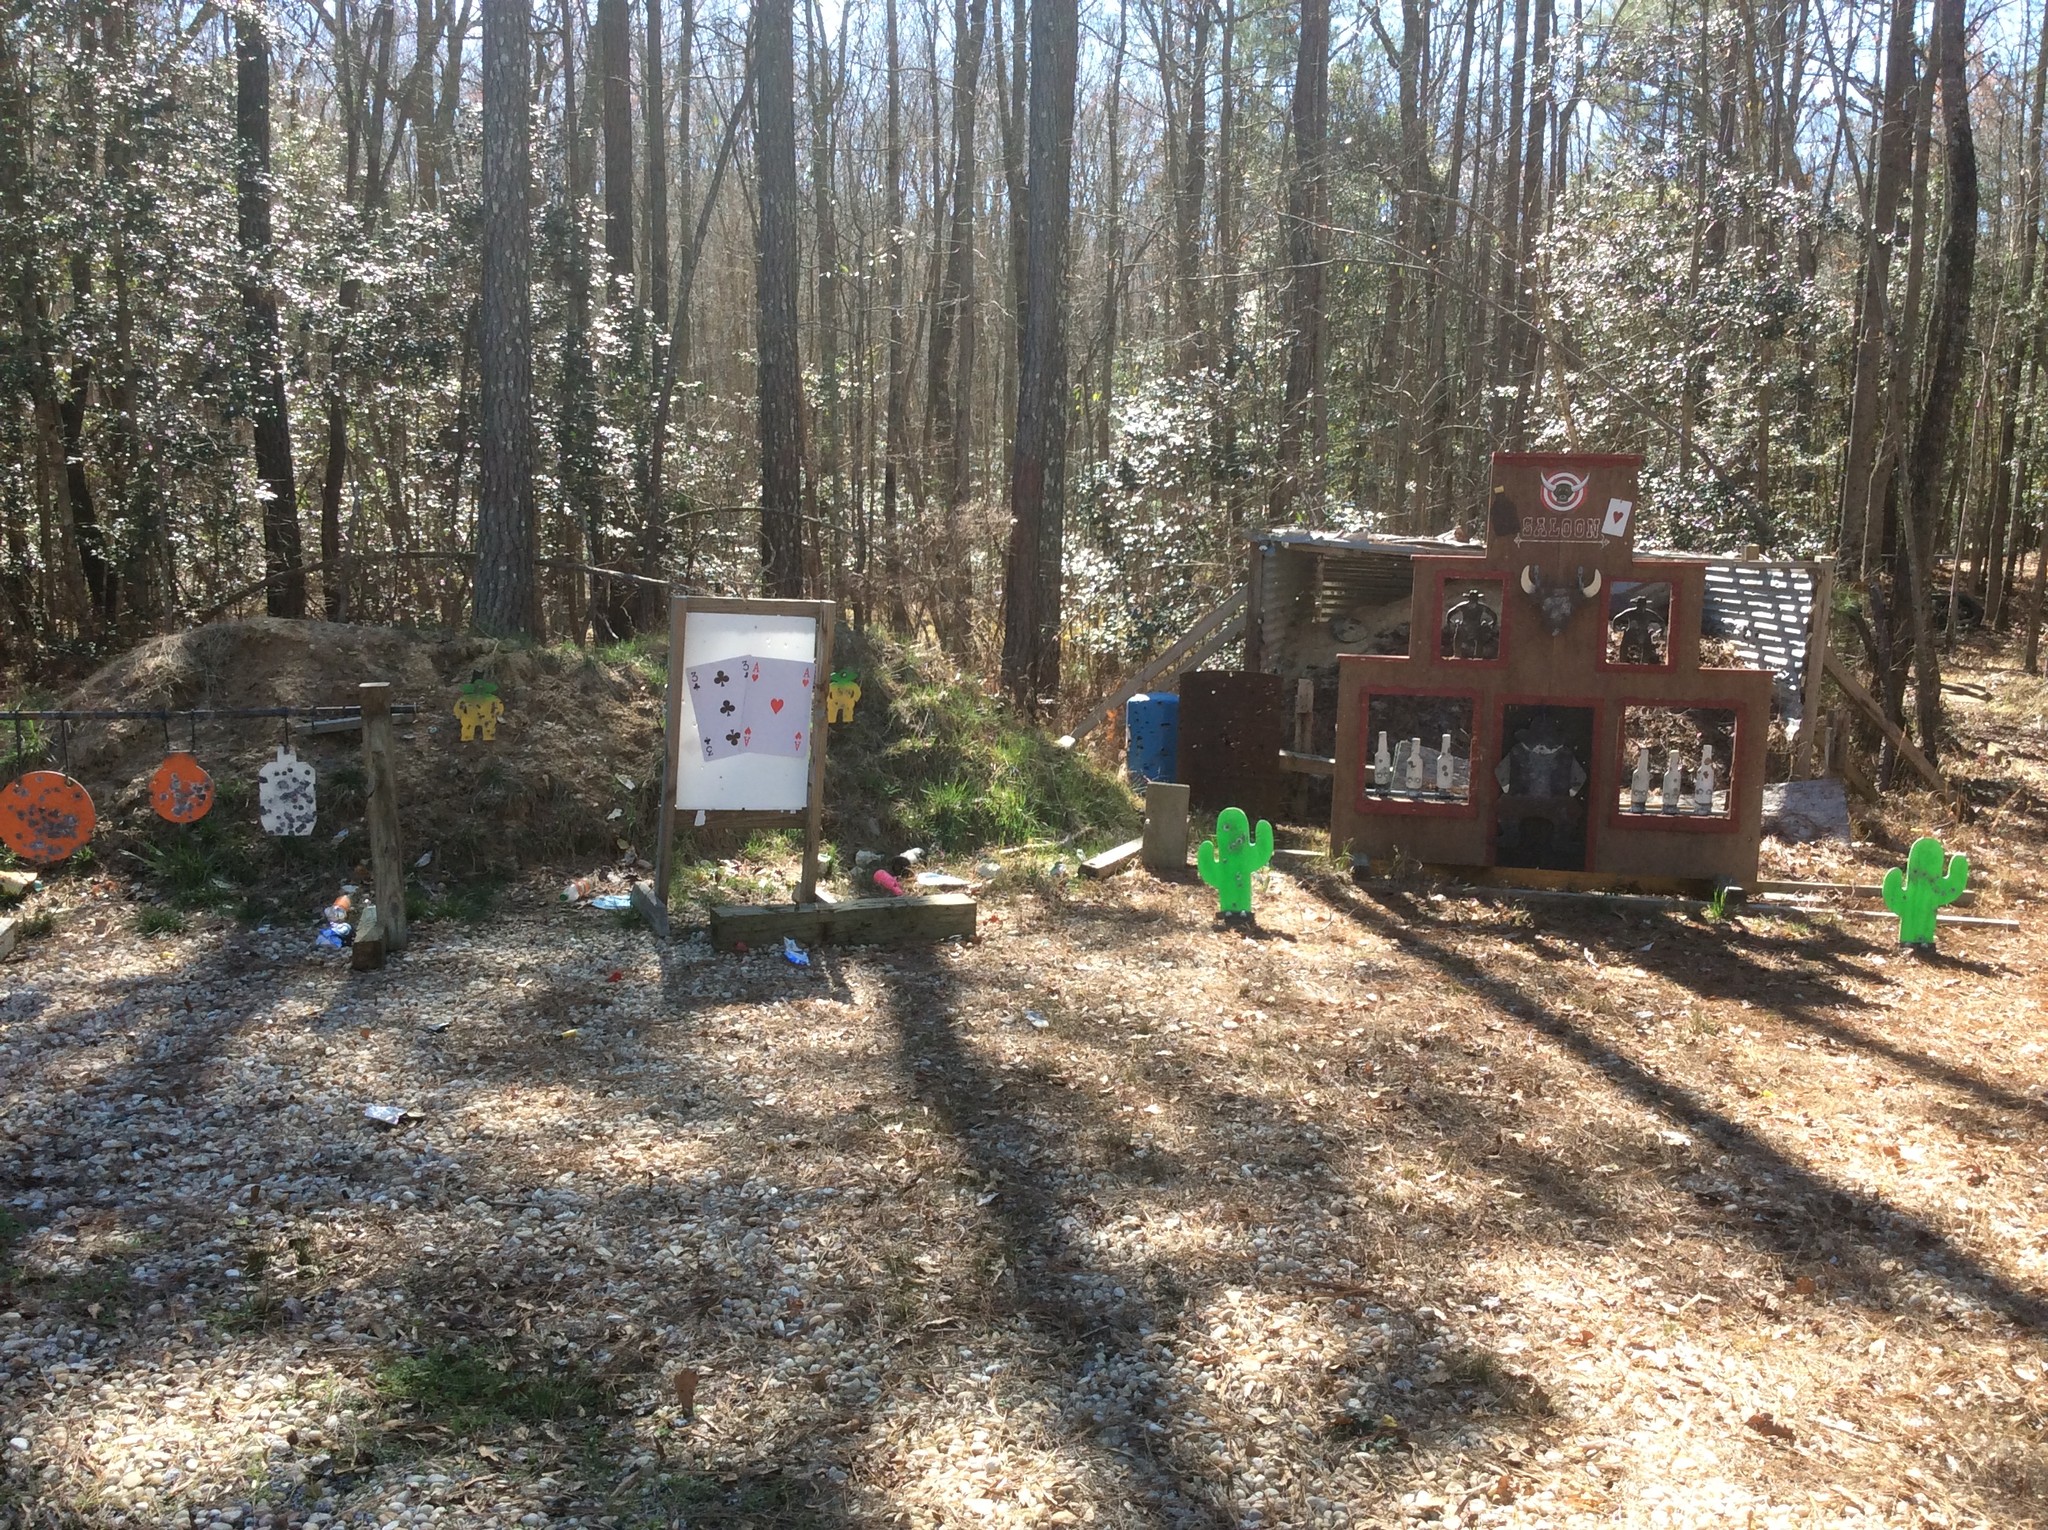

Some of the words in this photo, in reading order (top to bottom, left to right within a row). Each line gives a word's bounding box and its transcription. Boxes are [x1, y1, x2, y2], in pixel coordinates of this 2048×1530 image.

[1522, 517, 1601, 538] SALOON
[742, 660, 750, 671] 3
[752, 662, 760, 673] A
[690, 672, 698, 682] 3
[803, 668, 811, 678] A
[743, 736, 751, 747] A
[794, 741, 801, 751] A
[705, 745, 714, 756] 3
